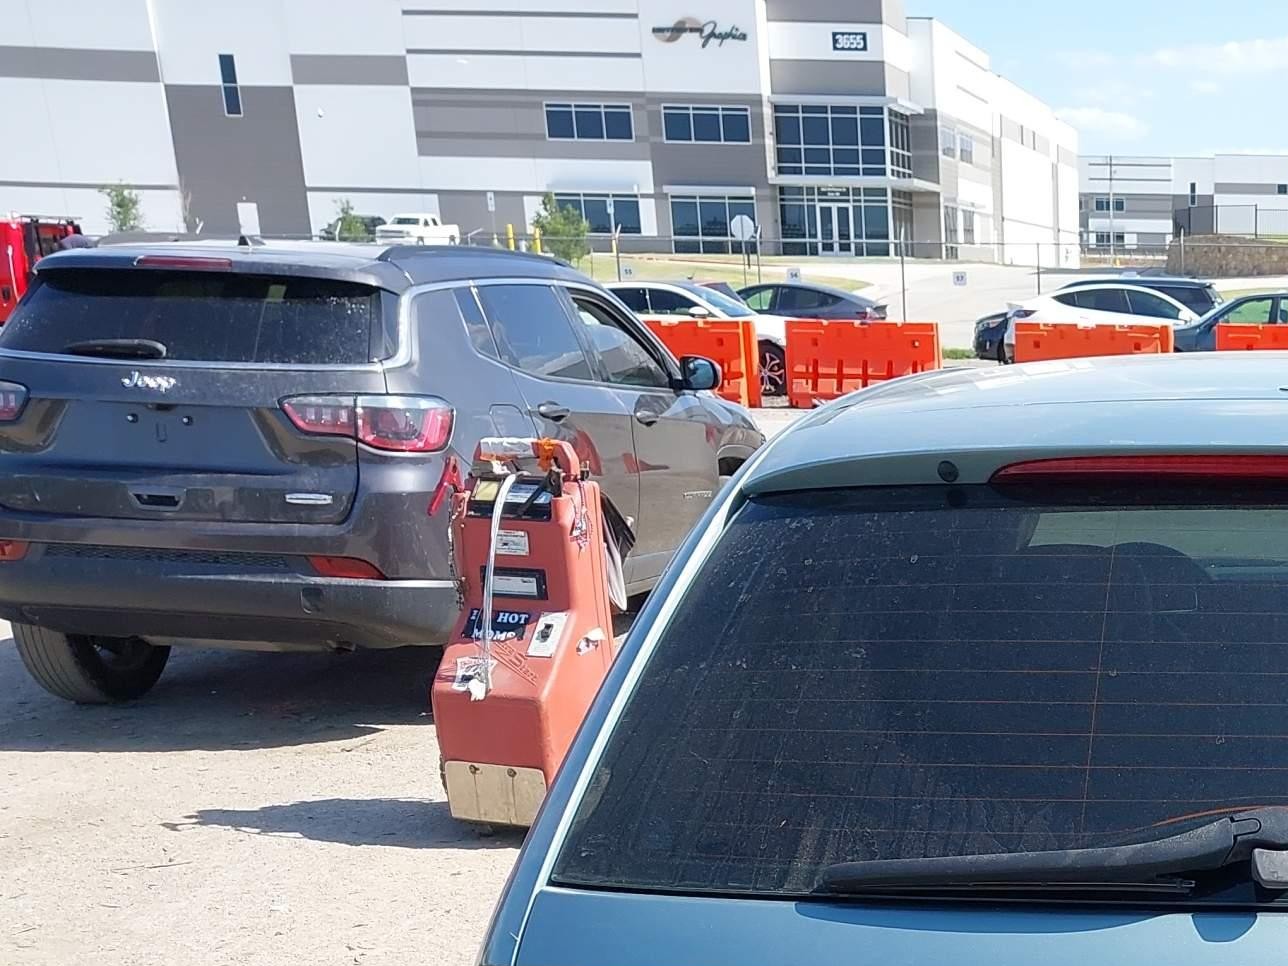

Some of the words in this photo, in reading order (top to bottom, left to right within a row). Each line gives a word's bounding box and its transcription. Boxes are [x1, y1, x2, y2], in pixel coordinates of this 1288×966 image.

[835, 34, 864, 49] 3655
[121, 371, 176, 394] Jeep
[497, 612, 529, 624] HOT
